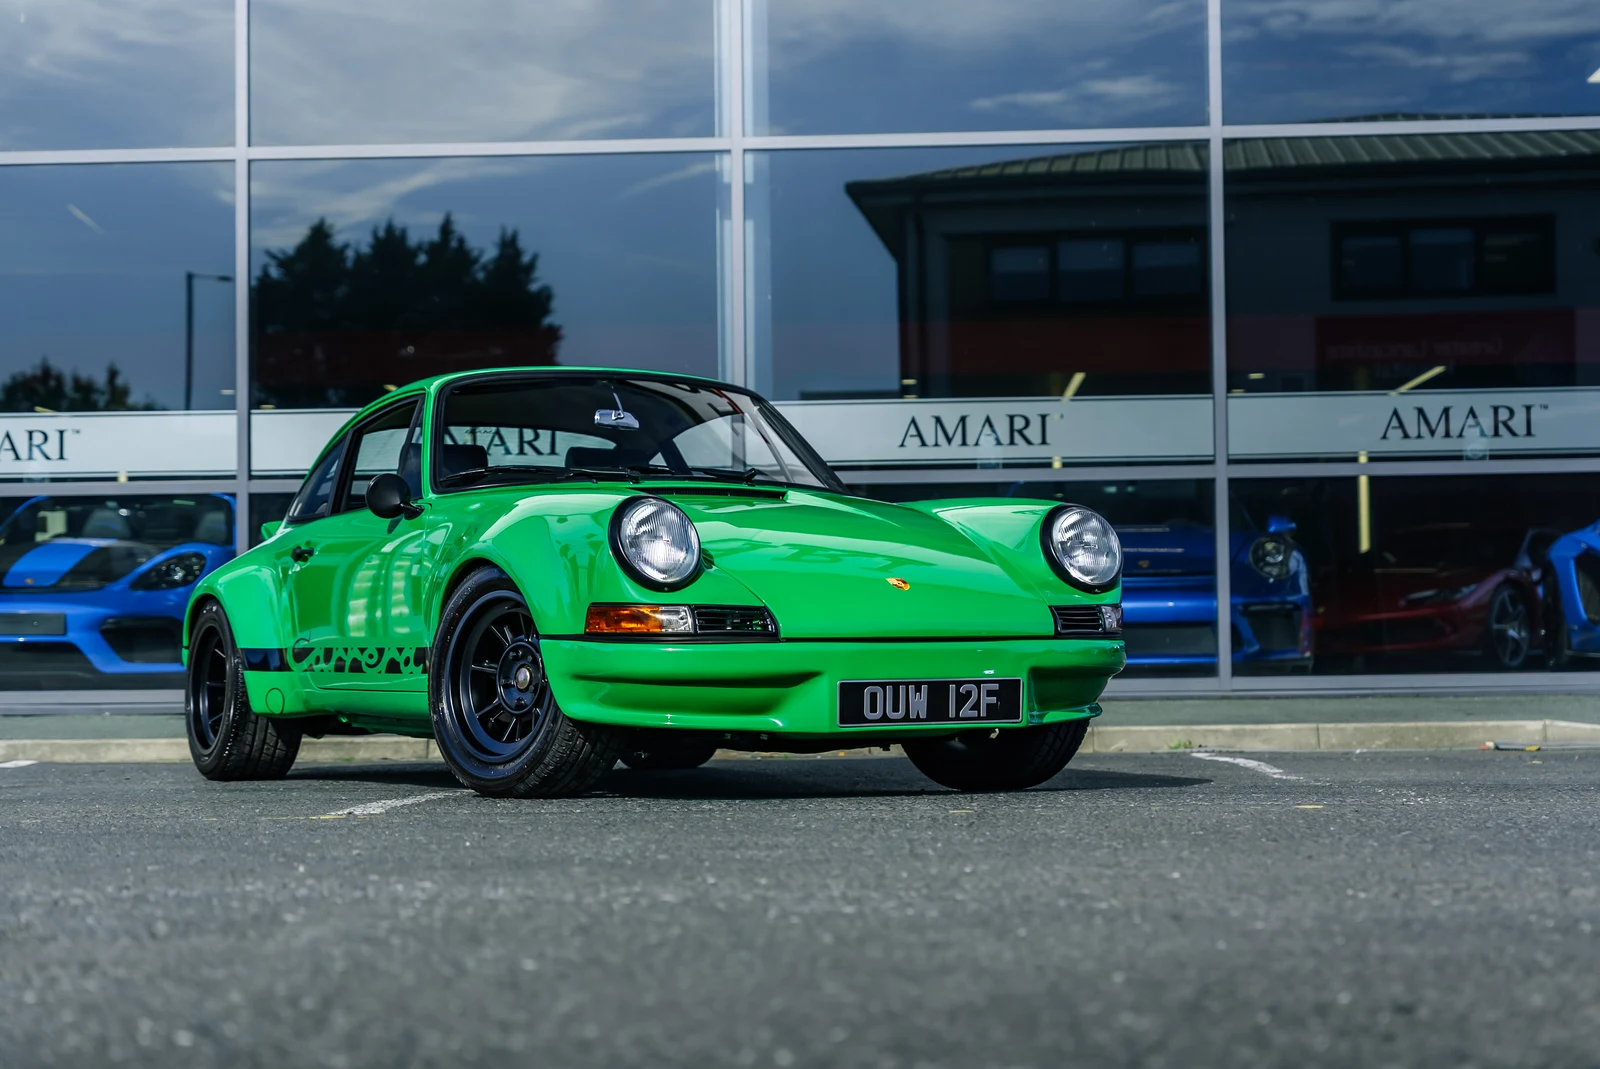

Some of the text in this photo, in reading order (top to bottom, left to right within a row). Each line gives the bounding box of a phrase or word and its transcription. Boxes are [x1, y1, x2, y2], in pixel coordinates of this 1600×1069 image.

[898, 413, 1051, 447] AMARI
[863, 683, 999, 720] OUW 12F
